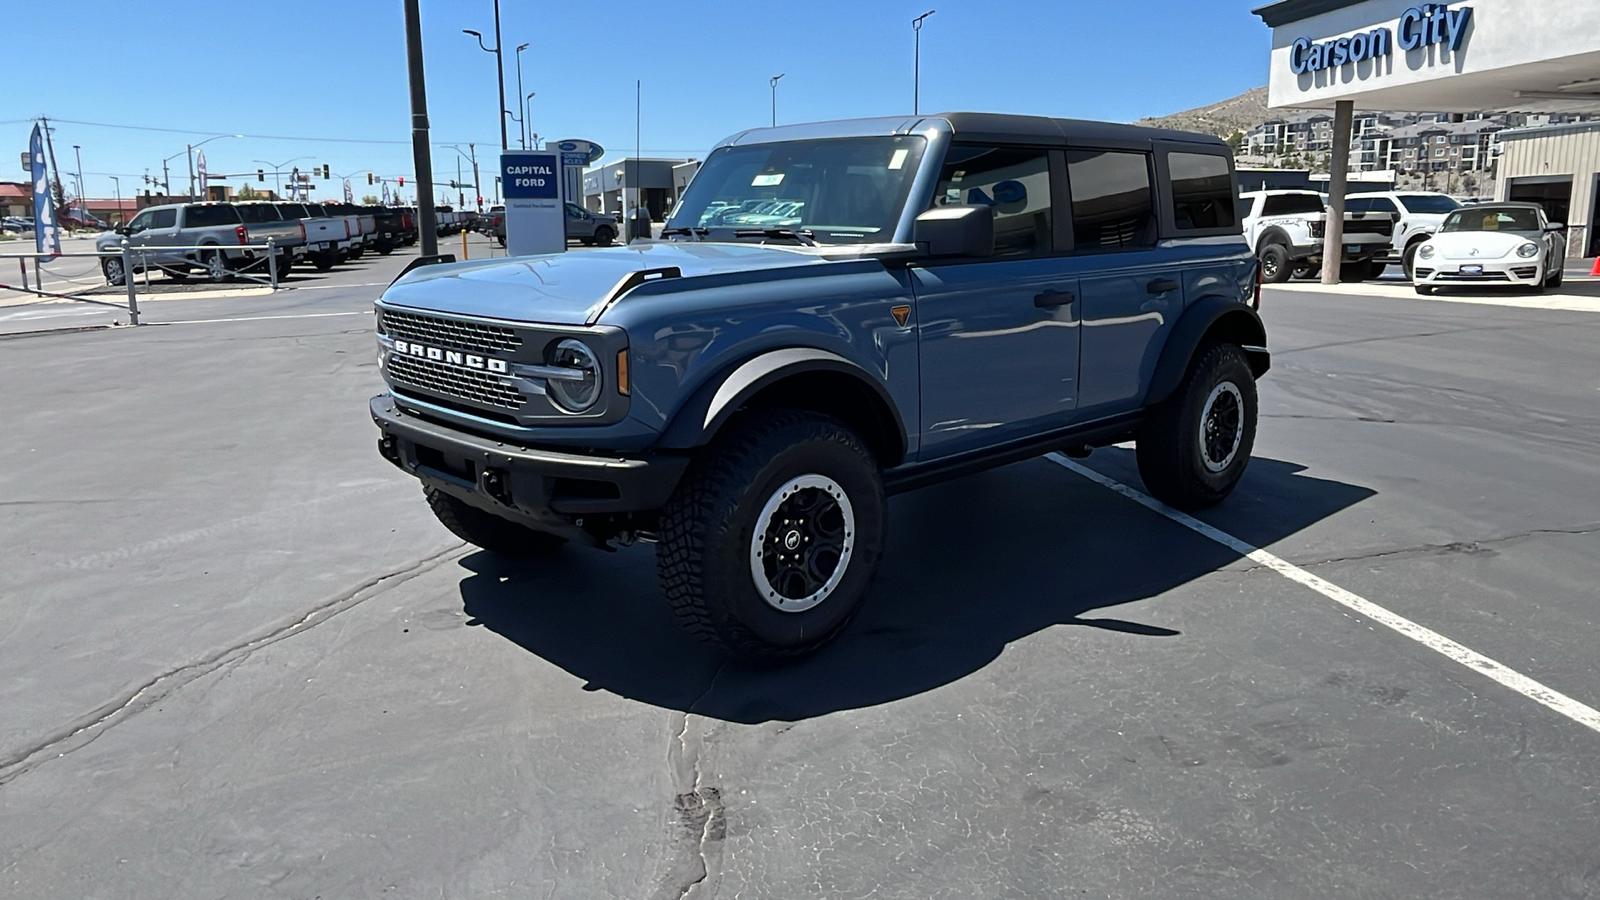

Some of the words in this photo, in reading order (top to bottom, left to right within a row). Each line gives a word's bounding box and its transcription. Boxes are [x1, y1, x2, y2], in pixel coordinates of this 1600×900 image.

[1290, 28, 1391, 75] Carson
[1398, 3, 1473, 51] City
[506, 165, 553, 175] CAPITAL
[515, 178, 546, 187] FORD
[395, 340, 509, 374] BRONCO
